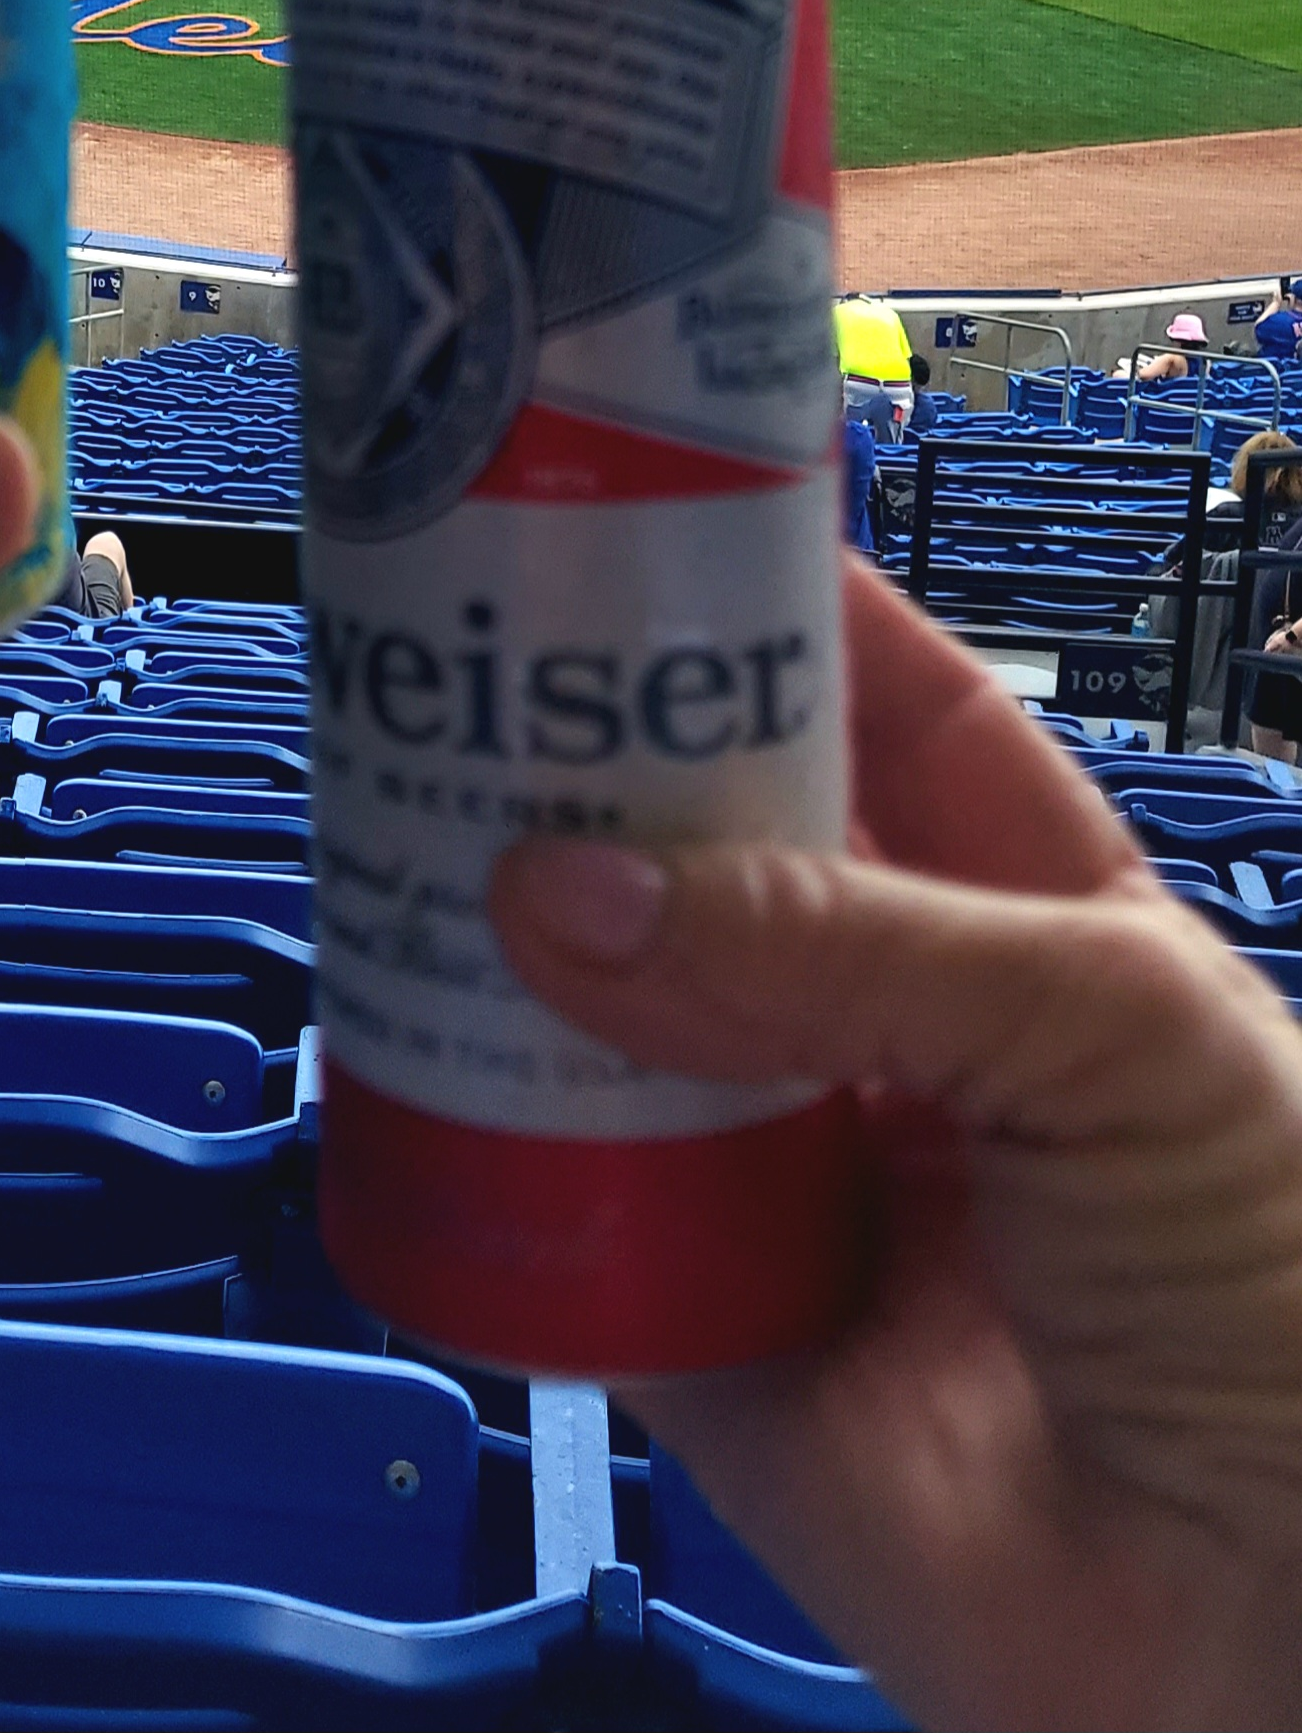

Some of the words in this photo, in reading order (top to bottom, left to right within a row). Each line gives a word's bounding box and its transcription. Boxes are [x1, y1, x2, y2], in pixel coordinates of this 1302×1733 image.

[92, 277, 106, 288] 10
[189, 291, 197, 301] 9
[1070, 669, 1126, 694] 109
